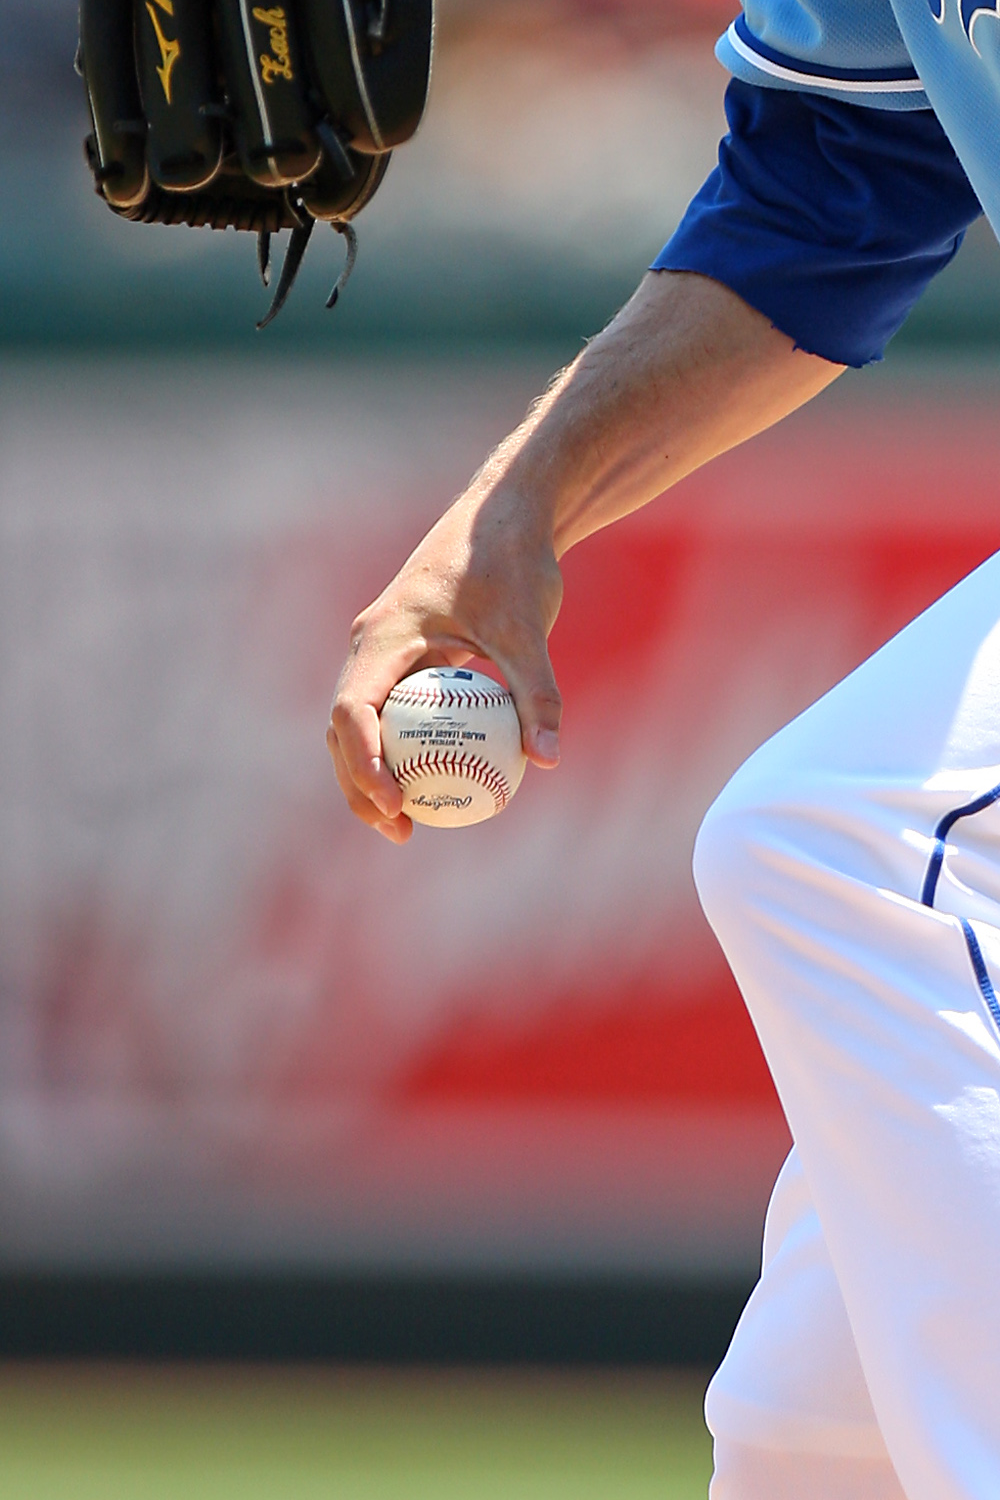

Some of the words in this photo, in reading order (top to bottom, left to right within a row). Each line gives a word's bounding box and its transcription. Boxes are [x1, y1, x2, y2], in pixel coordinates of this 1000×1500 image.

[252, 6, 294, 85] Zach
[399, 730, 433, 739] BASEBALL
[434, 730, 460, 739] LEAGUE
[461, 732, 487, 741] MAJOR
[410, 795, 473, 811] Rawlings
